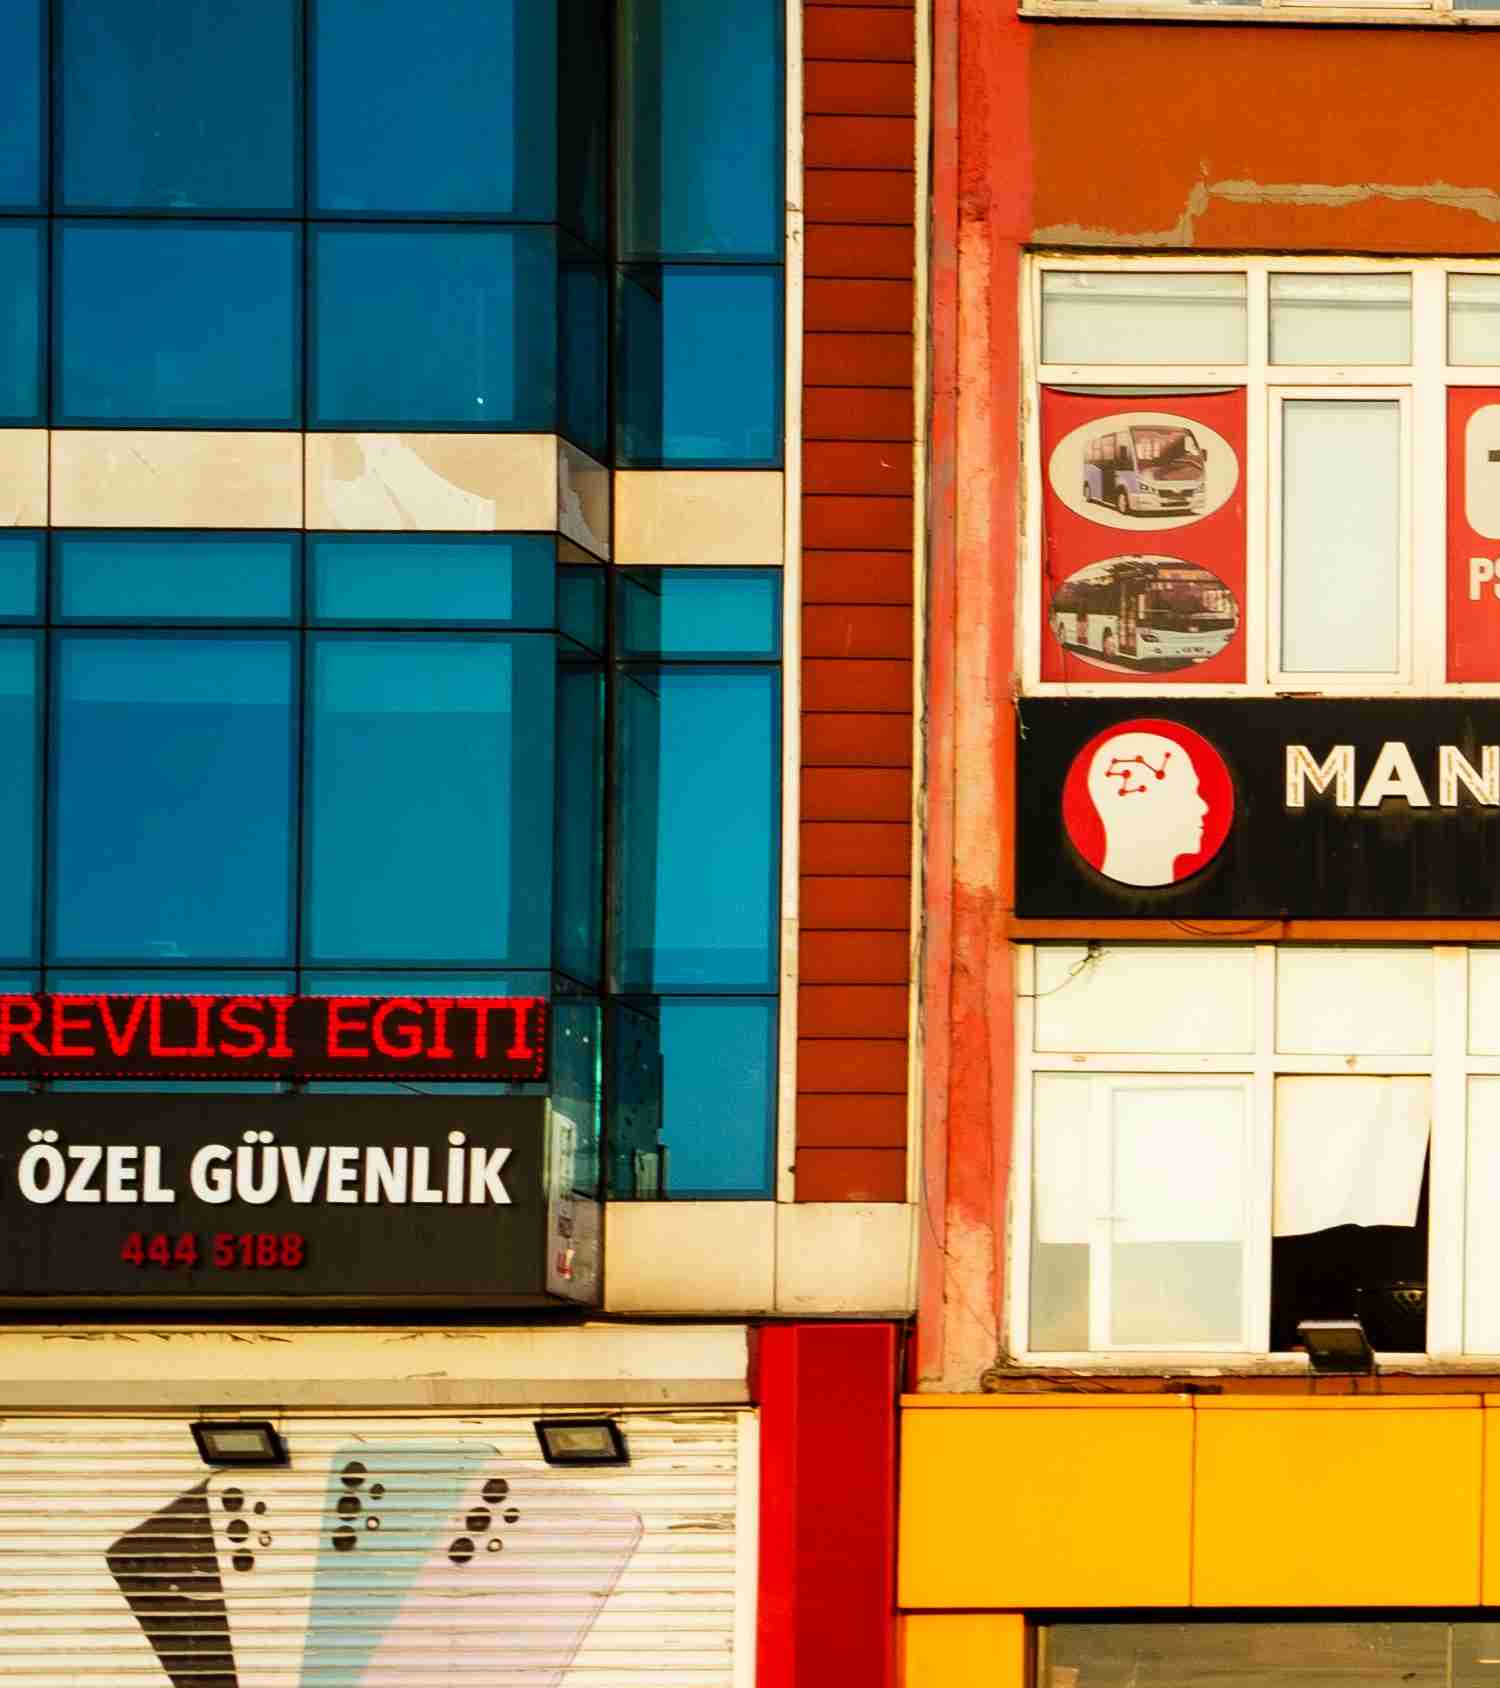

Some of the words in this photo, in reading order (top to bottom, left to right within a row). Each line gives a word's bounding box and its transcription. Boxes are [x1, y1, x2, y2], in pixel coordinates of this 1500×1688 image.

[18, 1128, 175, 1204] ÖZEL
[190, 1130, 512, 1204] GÜVENLİK
[121, 1231, 199, 1267] 444
[213, 1231, 305, 1269] 5188
